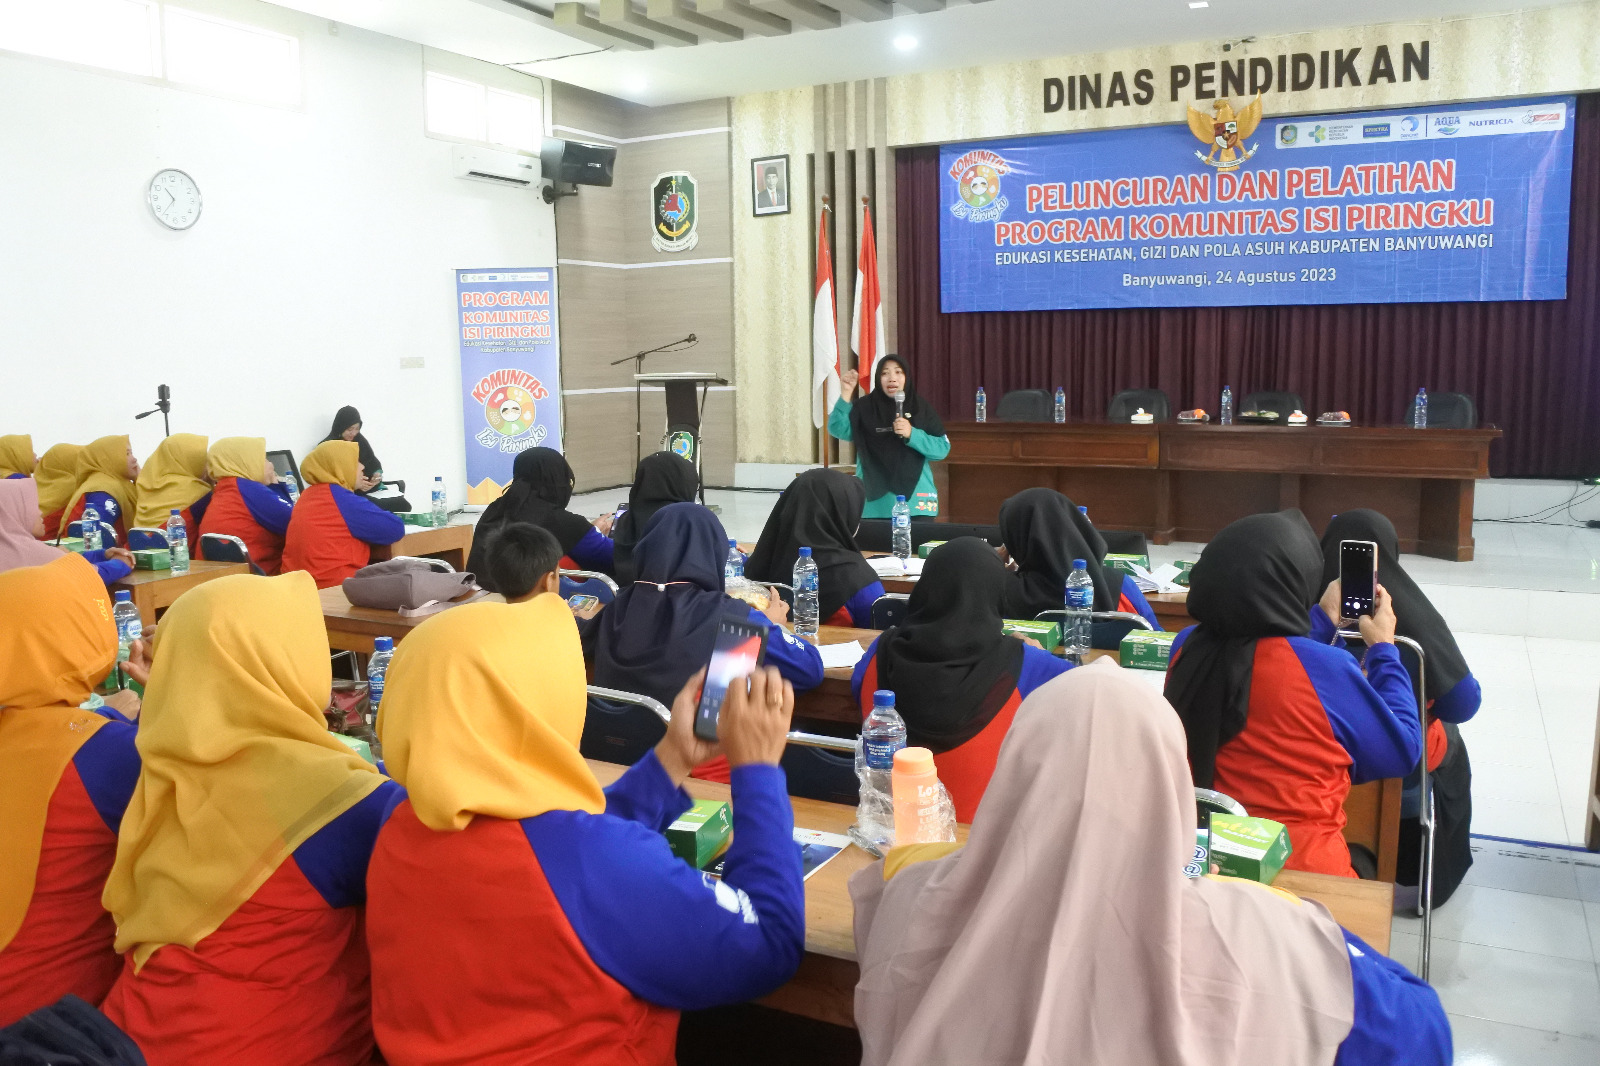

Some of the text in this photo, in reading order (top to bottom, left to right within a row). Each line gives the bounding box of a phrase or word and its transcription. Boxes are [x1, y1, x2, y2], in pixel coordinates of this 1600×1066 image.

[1043, 41, 1430, 113] DINAS PENDIDIKAN
[1434, 116, 1461, 126] AQUA
[1469, 118, 1514, 127] NUTRICIA
[949, 150, 1009, 181] KOMUNITAS
[1027, 159, 1455, 212] PELUNCURAN DAN PELATIHAN
[995, 198, 1493, 246] PROGRAM KOMUNITAS ISI PIRINGKU
[995, 233, 1493, 265] EDUKASI KESEHATAN, GIZI DAN POLA ASUH KABUPATEN BANYUWANGI
[1122, 268, 1337, 288] Banyuwangi, 24 Agustus 2023
[462, 291, 549, 307] PROGRAM
[463, 310, 550, 324] KOMUNITAS
[463, 325, 551, 339] ISI PIRINGKU
[472, 369, 549, 404] KOMUNITAS
